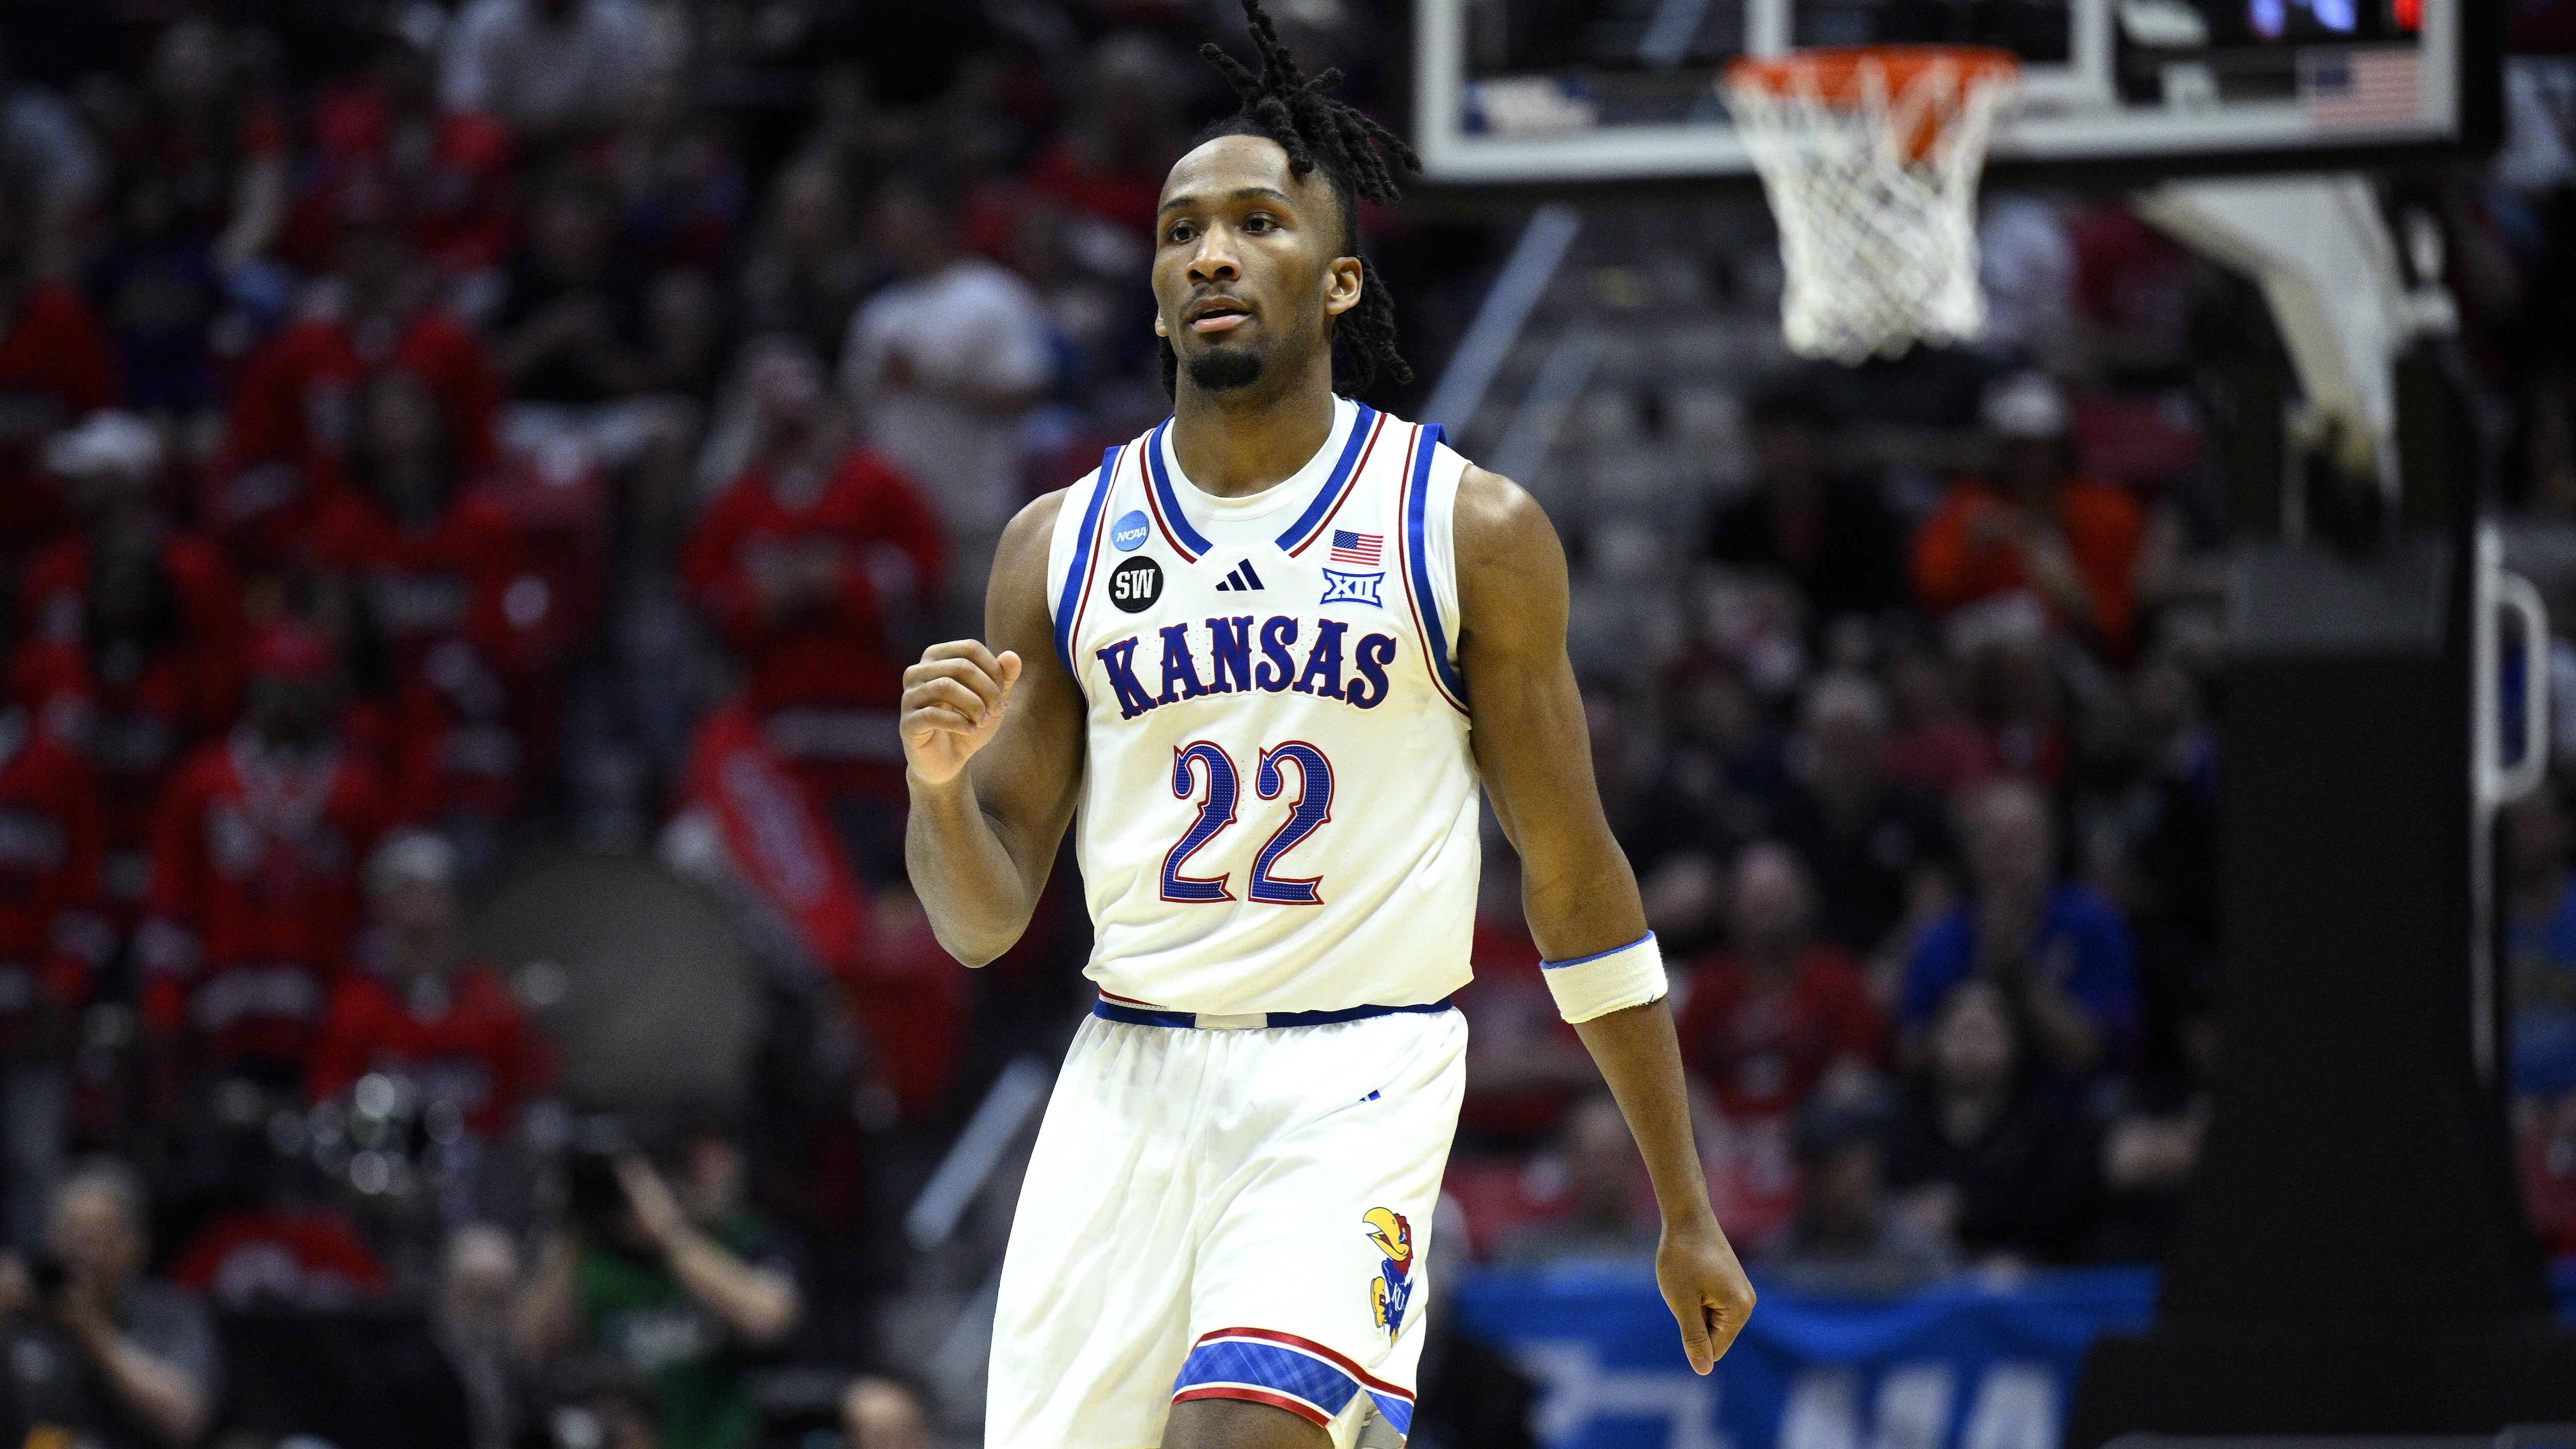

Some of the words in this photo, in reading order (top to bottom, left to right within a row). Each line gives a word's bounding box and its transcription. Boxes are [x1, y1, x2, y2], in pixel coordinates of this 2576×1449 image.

[1116, 526, 1147, 542] NCAA
[1115, 568, 1156, 600] SW
[1320, 568, 1385, 608] XII
[1096, 615, 1397, 721] KANSAS
[1160, 740, 1335, 905] 22
[1391, 1283, 1405, 1312] KU
